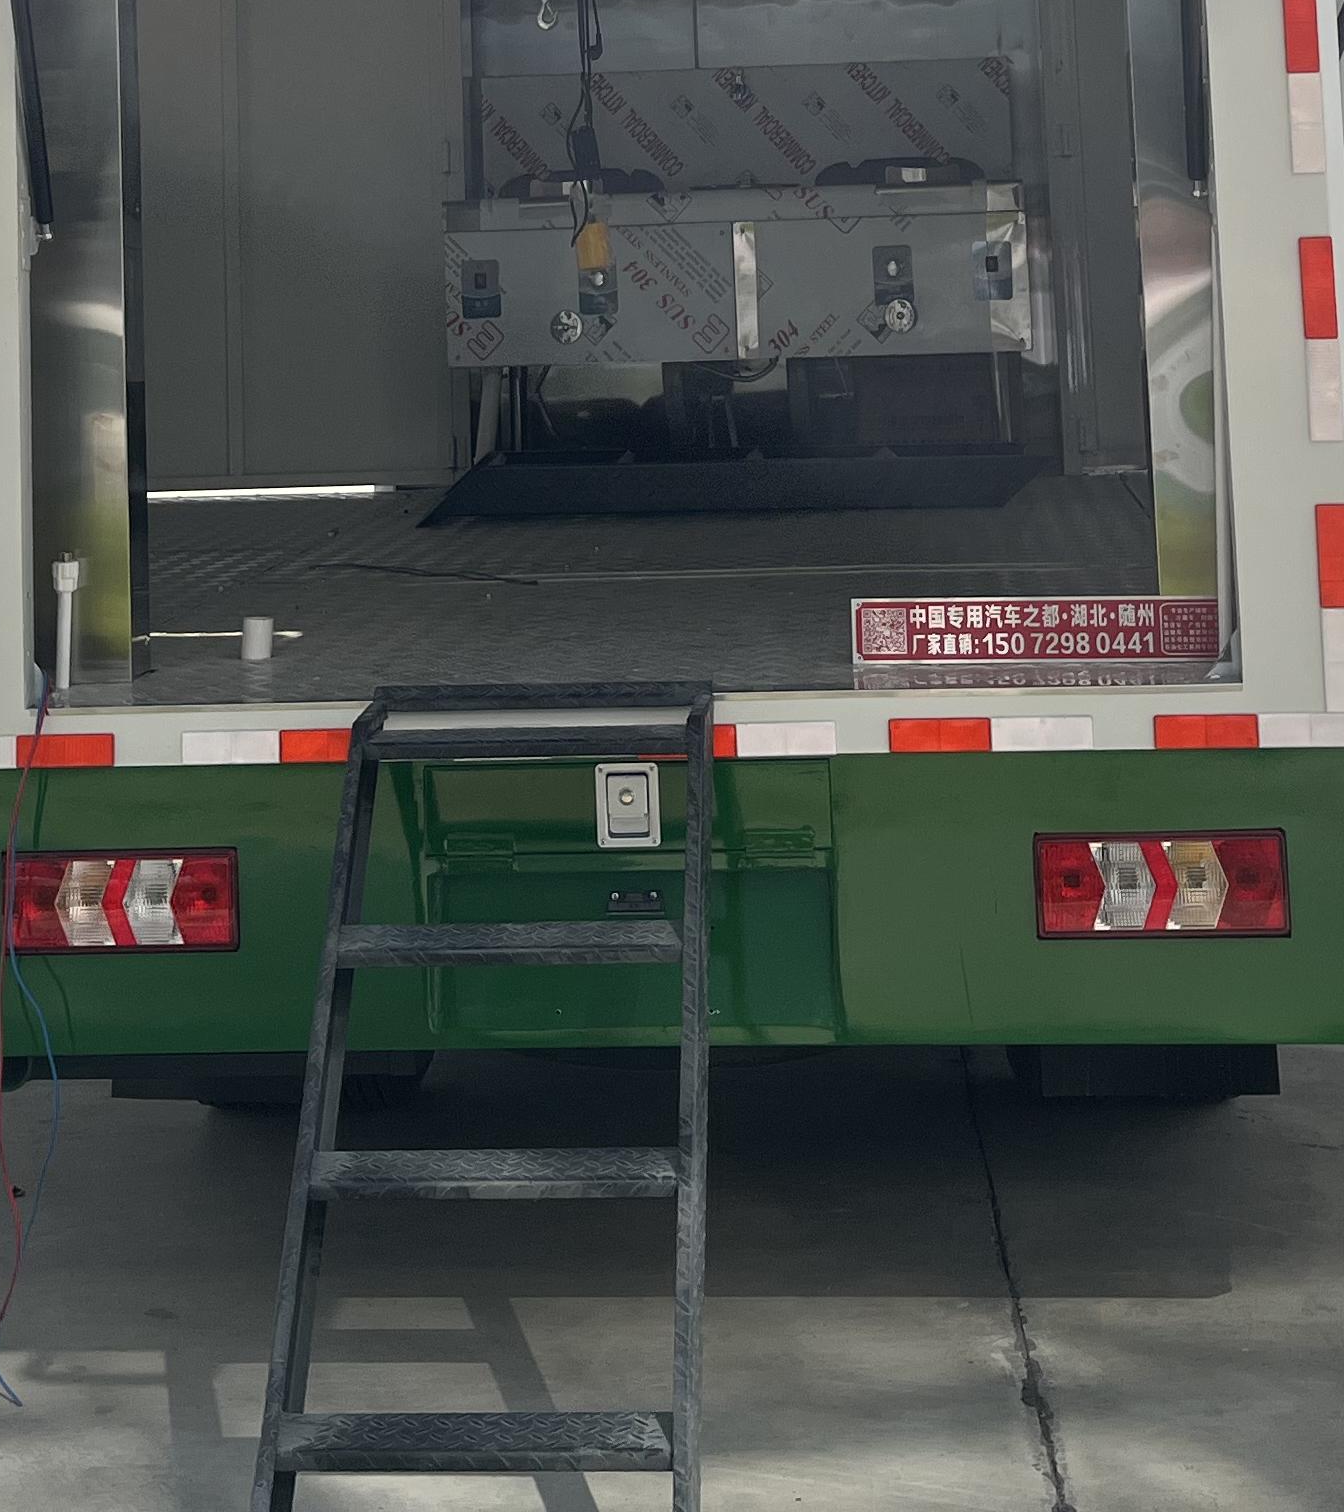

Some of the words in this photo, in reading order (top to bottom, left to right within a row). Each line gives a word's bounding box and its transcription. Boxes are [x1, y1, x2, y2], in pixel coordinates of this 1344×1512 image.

[589, 72, 628, 116] KITCHE
[622, 107, 686, 177] COMMERCIAL
[753, 105, 817, 176] COMMERCIAL
[792, 186, 835, 219] SUS
[622, 260, 658, 292] 304
[656, 293, 697, 330] SUS
[768, 319, 801, 354] 304
[1031, 631, 1091, 655] 7298
[1094, 630, 1155, 655] 0441
